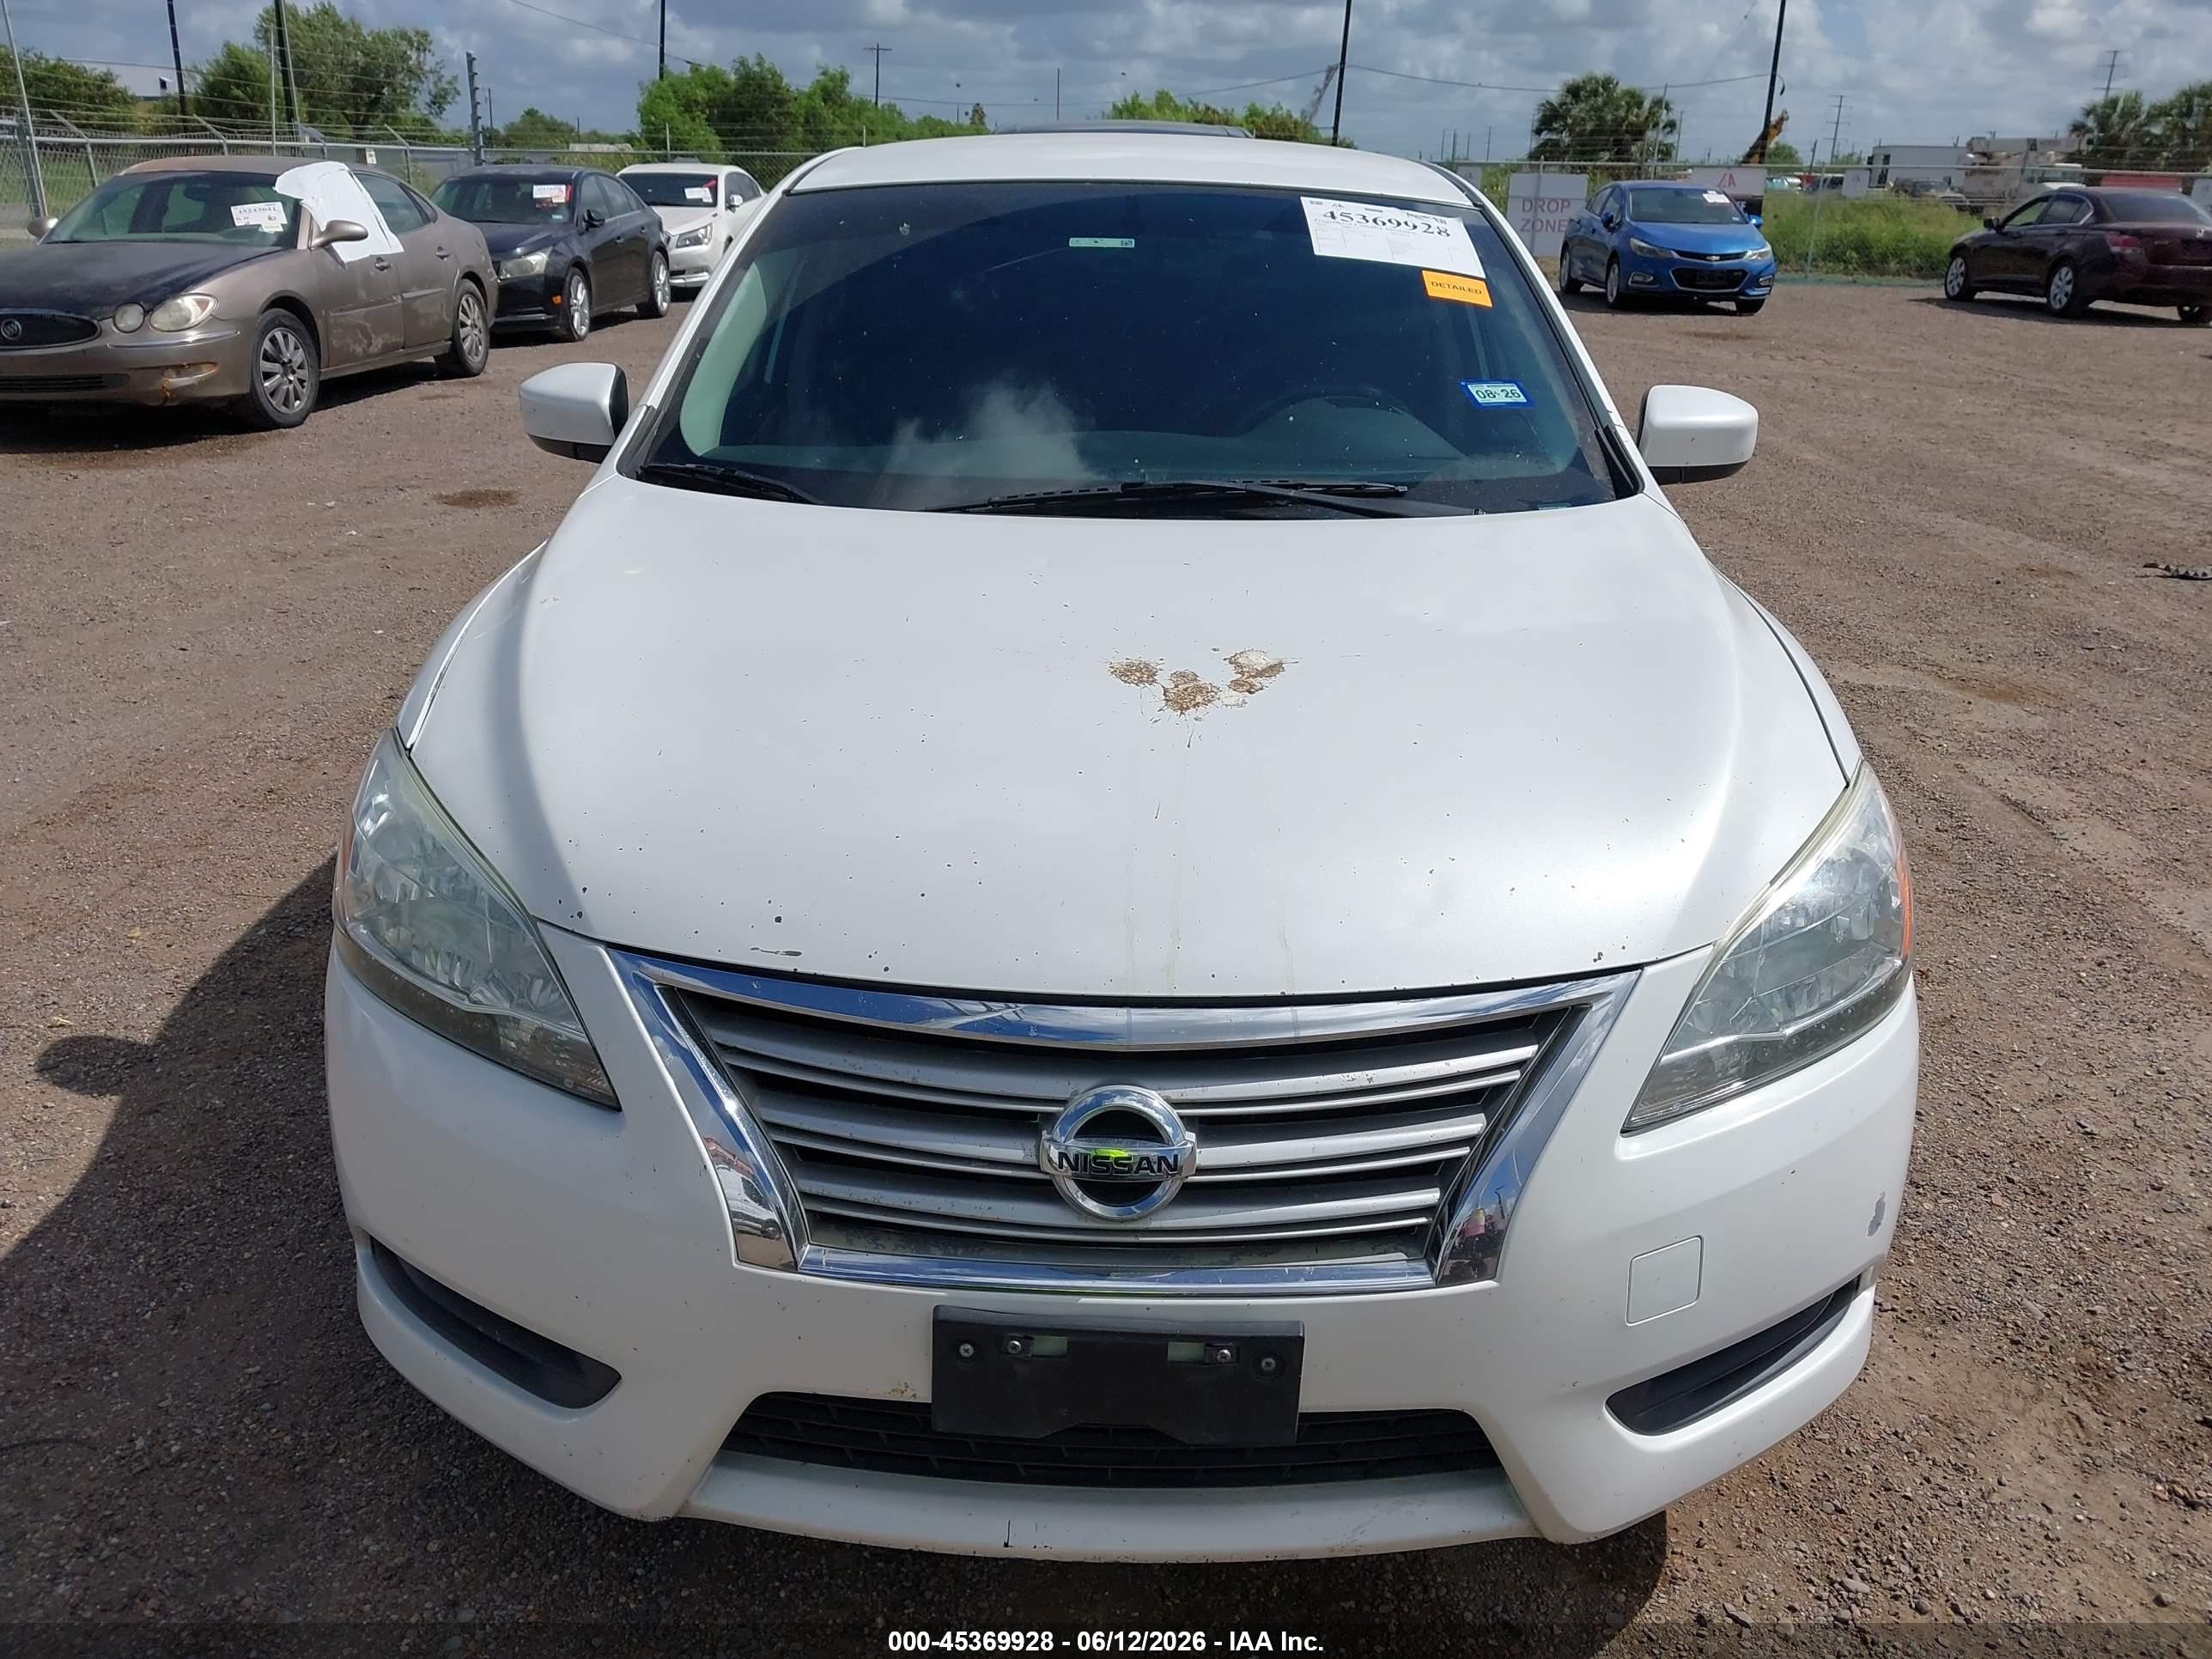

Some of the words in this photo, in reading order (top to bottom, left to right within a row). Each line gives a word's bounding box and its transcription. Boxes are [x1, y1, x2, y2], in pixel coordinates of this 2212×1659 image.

[1521, 198, 1571, 214] DROP
[1322, 210, 1451, 238] 45369928
[1519, 218, 1567, 234] ZONE
[1430, 281, 1483, 295] DETAILED
[1057, 1151, 1179, 1176] NISSAN
